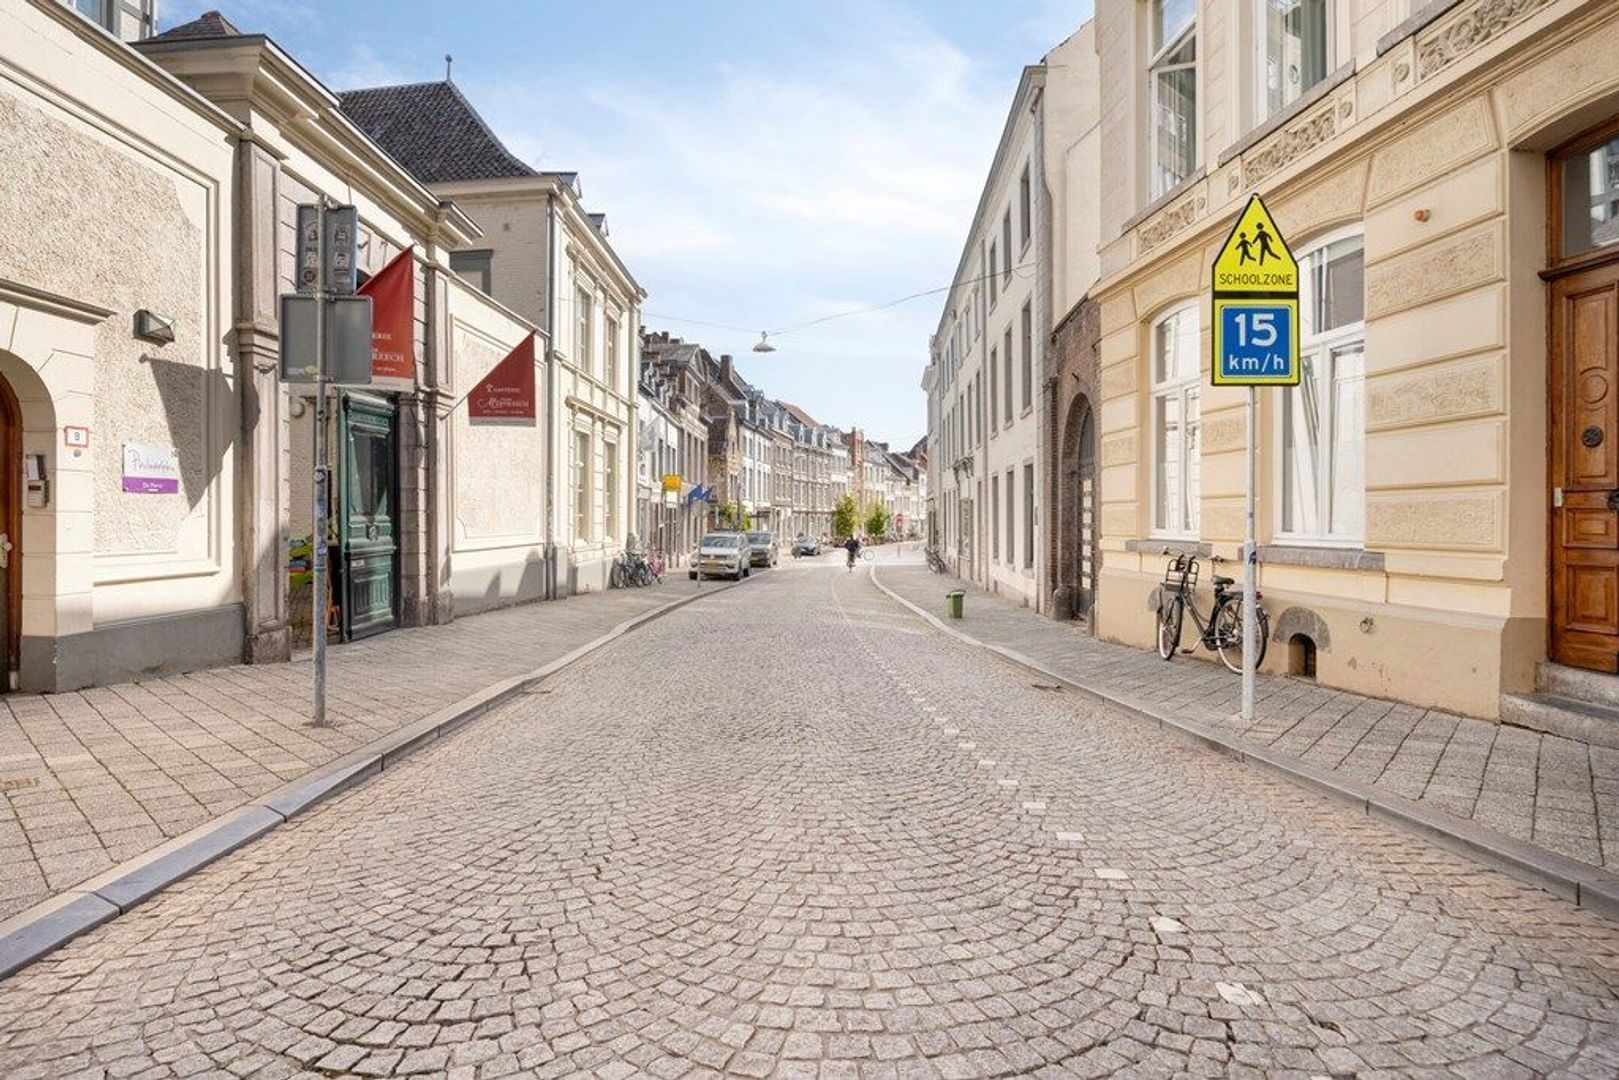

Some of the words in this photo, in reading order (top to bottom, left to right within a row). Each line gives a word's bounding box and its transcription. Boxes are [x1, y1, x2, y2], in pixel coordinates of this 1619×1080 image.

[1220, 274, 1293, 286] SCHOOLZONE
[1234, 313, 1278, 347] 15
[1229, 353, 1284, 373] km/h
